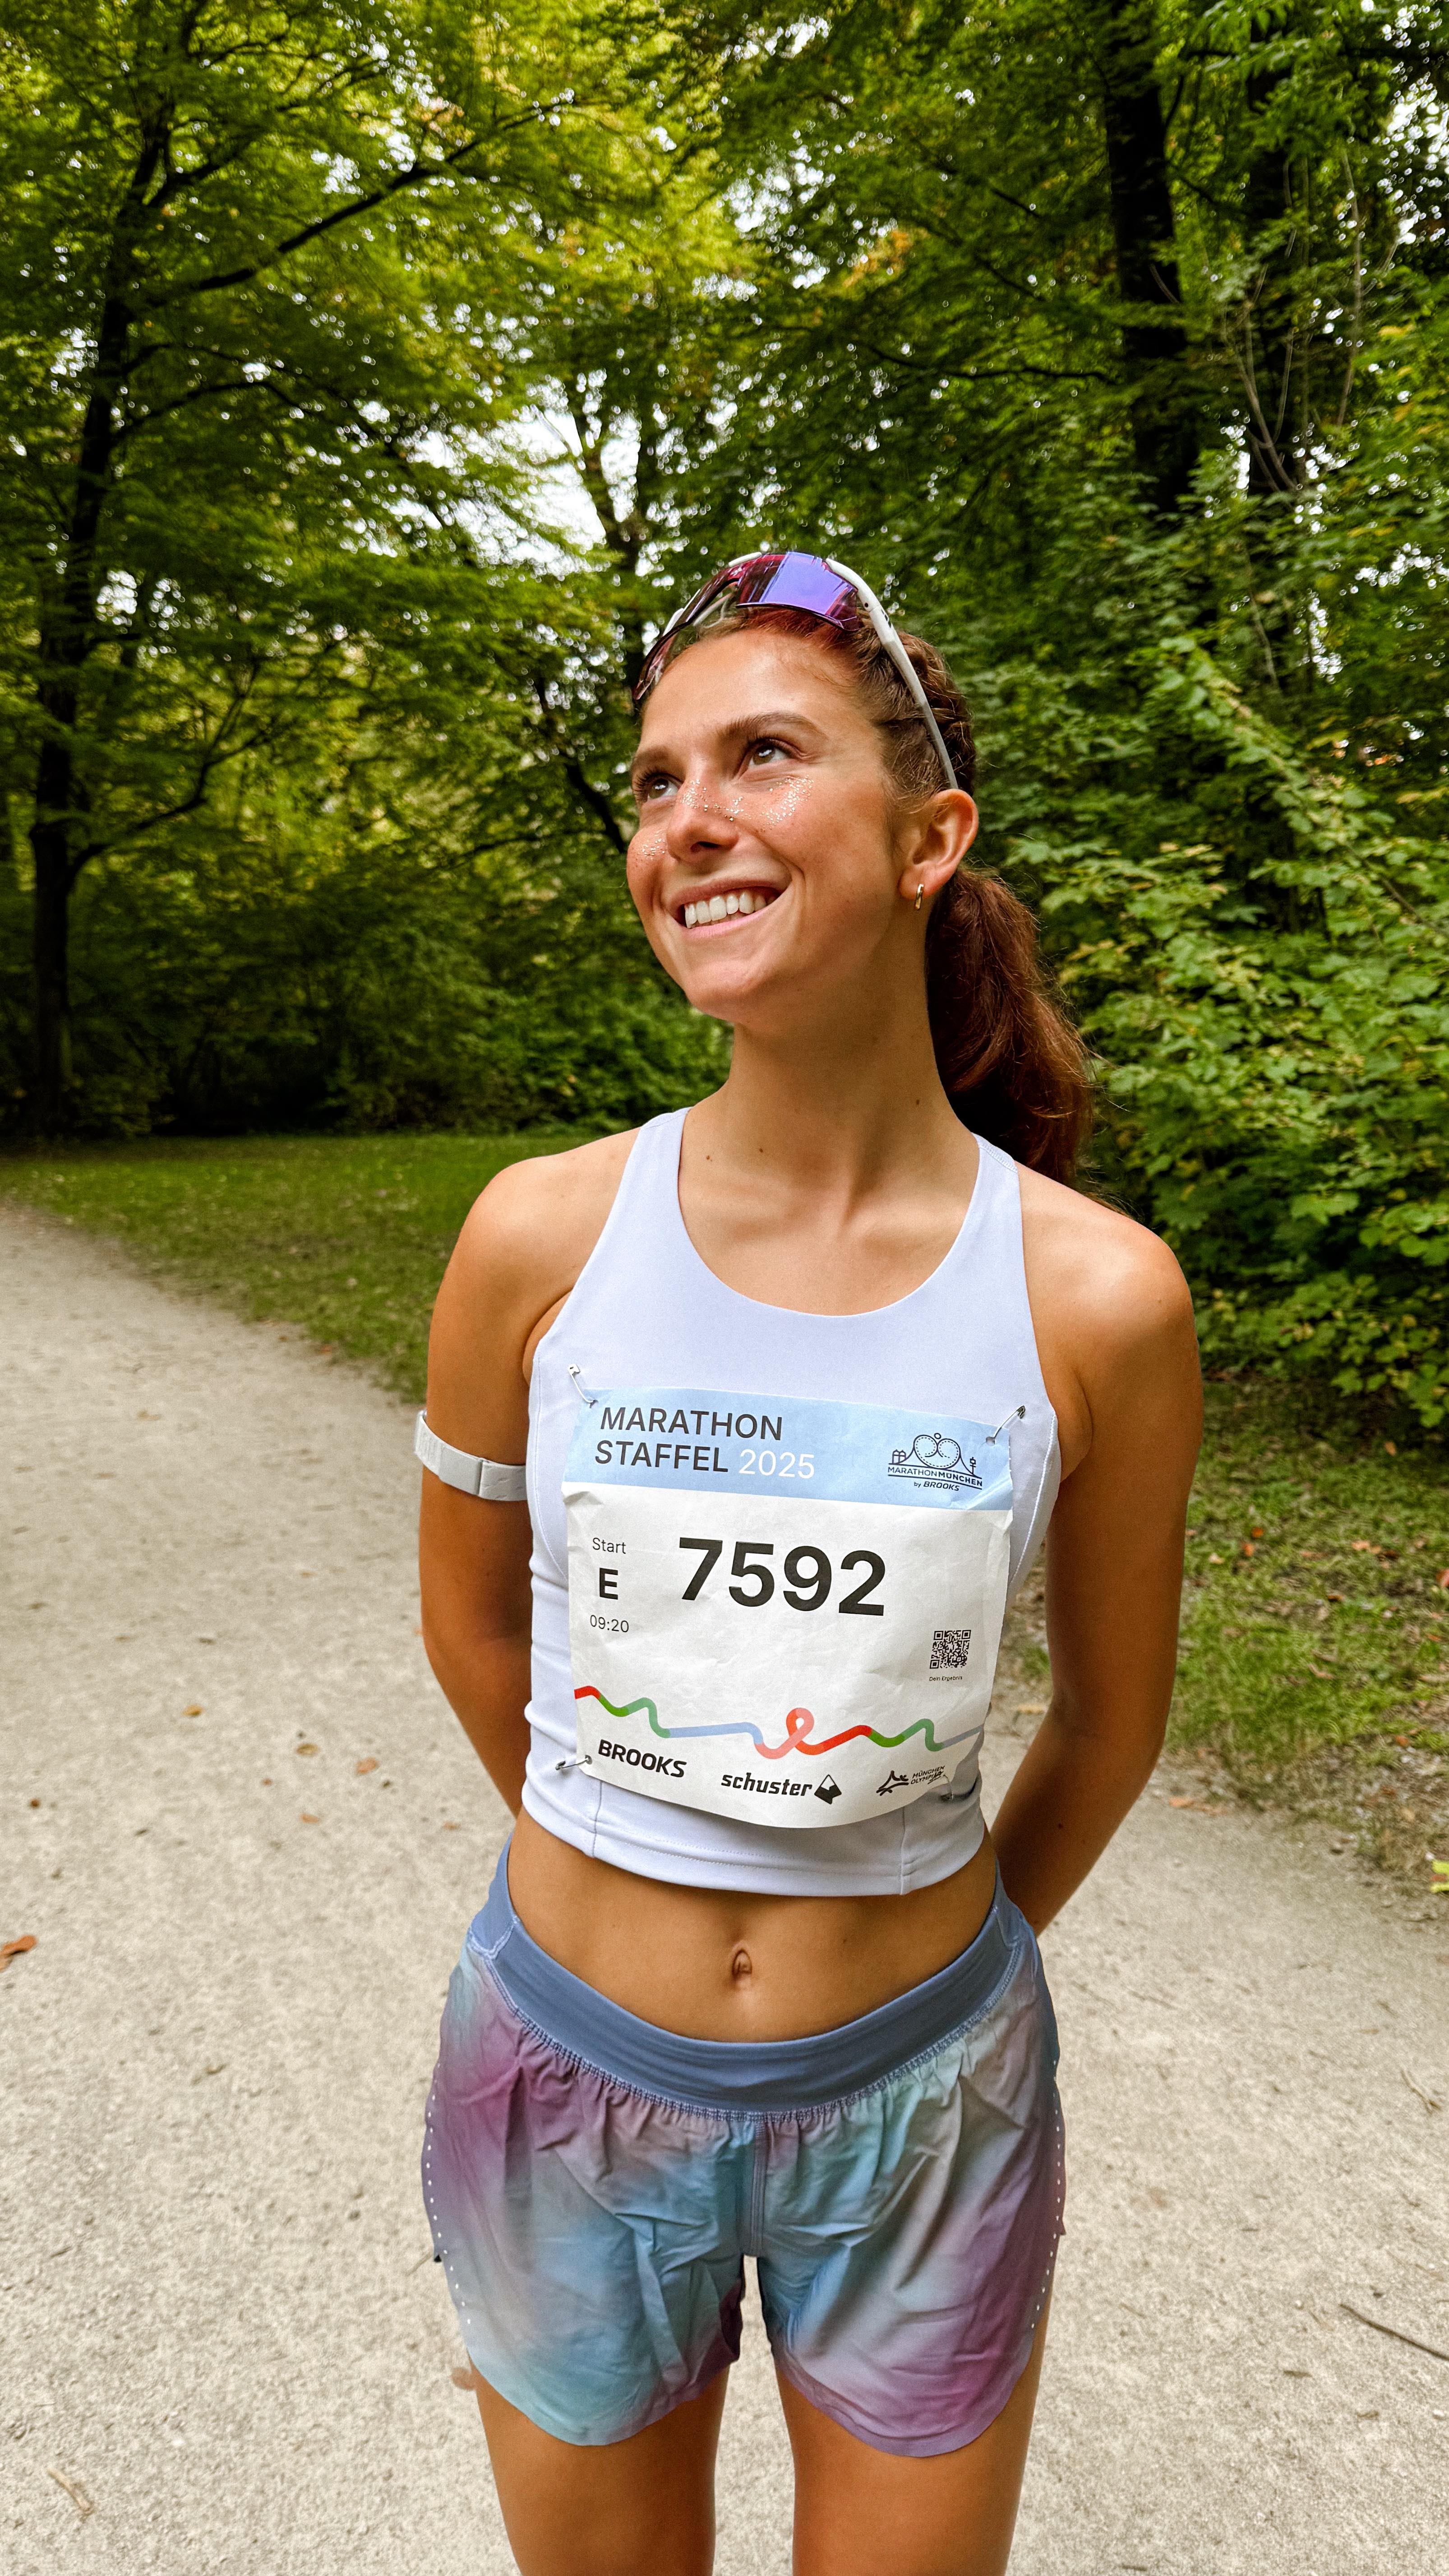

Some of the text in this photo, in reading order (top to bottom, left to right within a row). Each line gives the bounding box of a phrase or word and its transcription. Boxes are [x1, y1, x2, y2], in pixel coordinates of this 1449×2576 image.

[600, 1407, 782, 1441] MARATHON
[595, 1440, 815, 1479] STAFFEL 2025
[923, 1481, 960, 1491] BROOKS
[592, 1537, 626, 1554] Start
[599, 1567, 618, 1600] E
[679, 1537, 885, 1616] 7592
[590, 1615, 629, 1633] 09:20
[598, 1739, 687, 1778] BROOKS
[912, 1765, 945, 1779] MÜNCHEN
[721, 1772, 812, 1796] schuster
